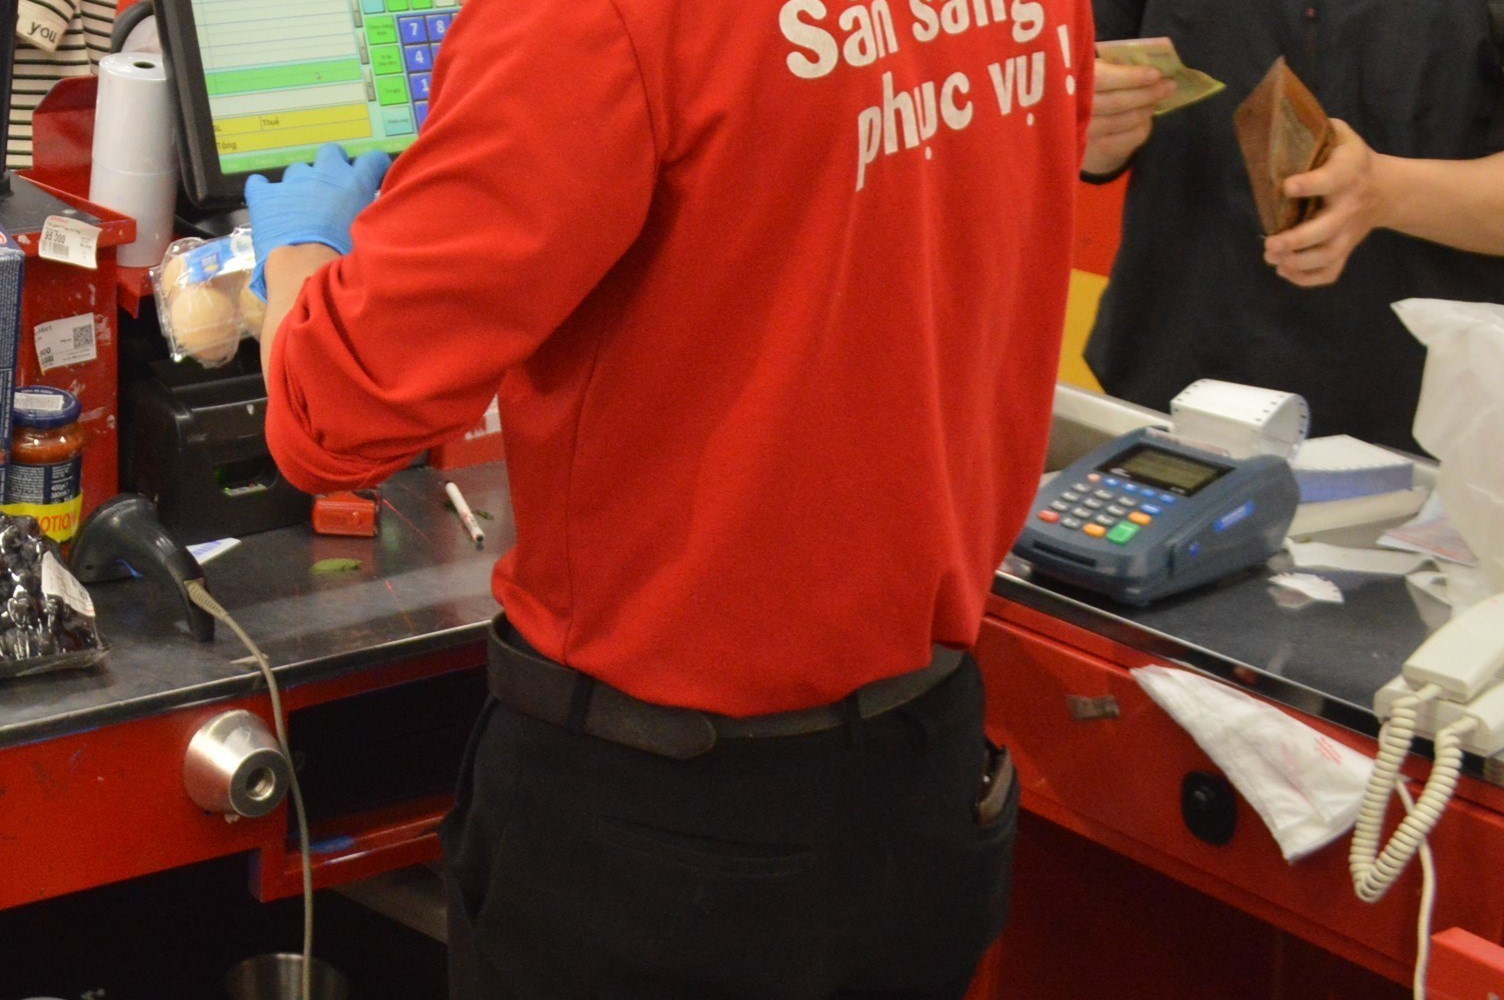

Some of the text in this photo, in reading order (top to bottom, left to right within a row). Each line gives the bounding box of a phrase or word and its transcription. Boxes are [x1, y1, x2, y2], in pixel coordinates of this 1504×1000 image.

[27, 20, 58, 44] you
[409, 23, 418, 36] 7
[435, 20, 445, 34] 8
[415, 50, 424, 64] 4
[855, 70, 974, 193] phục
[987, 50, 1045, 127] vụ
